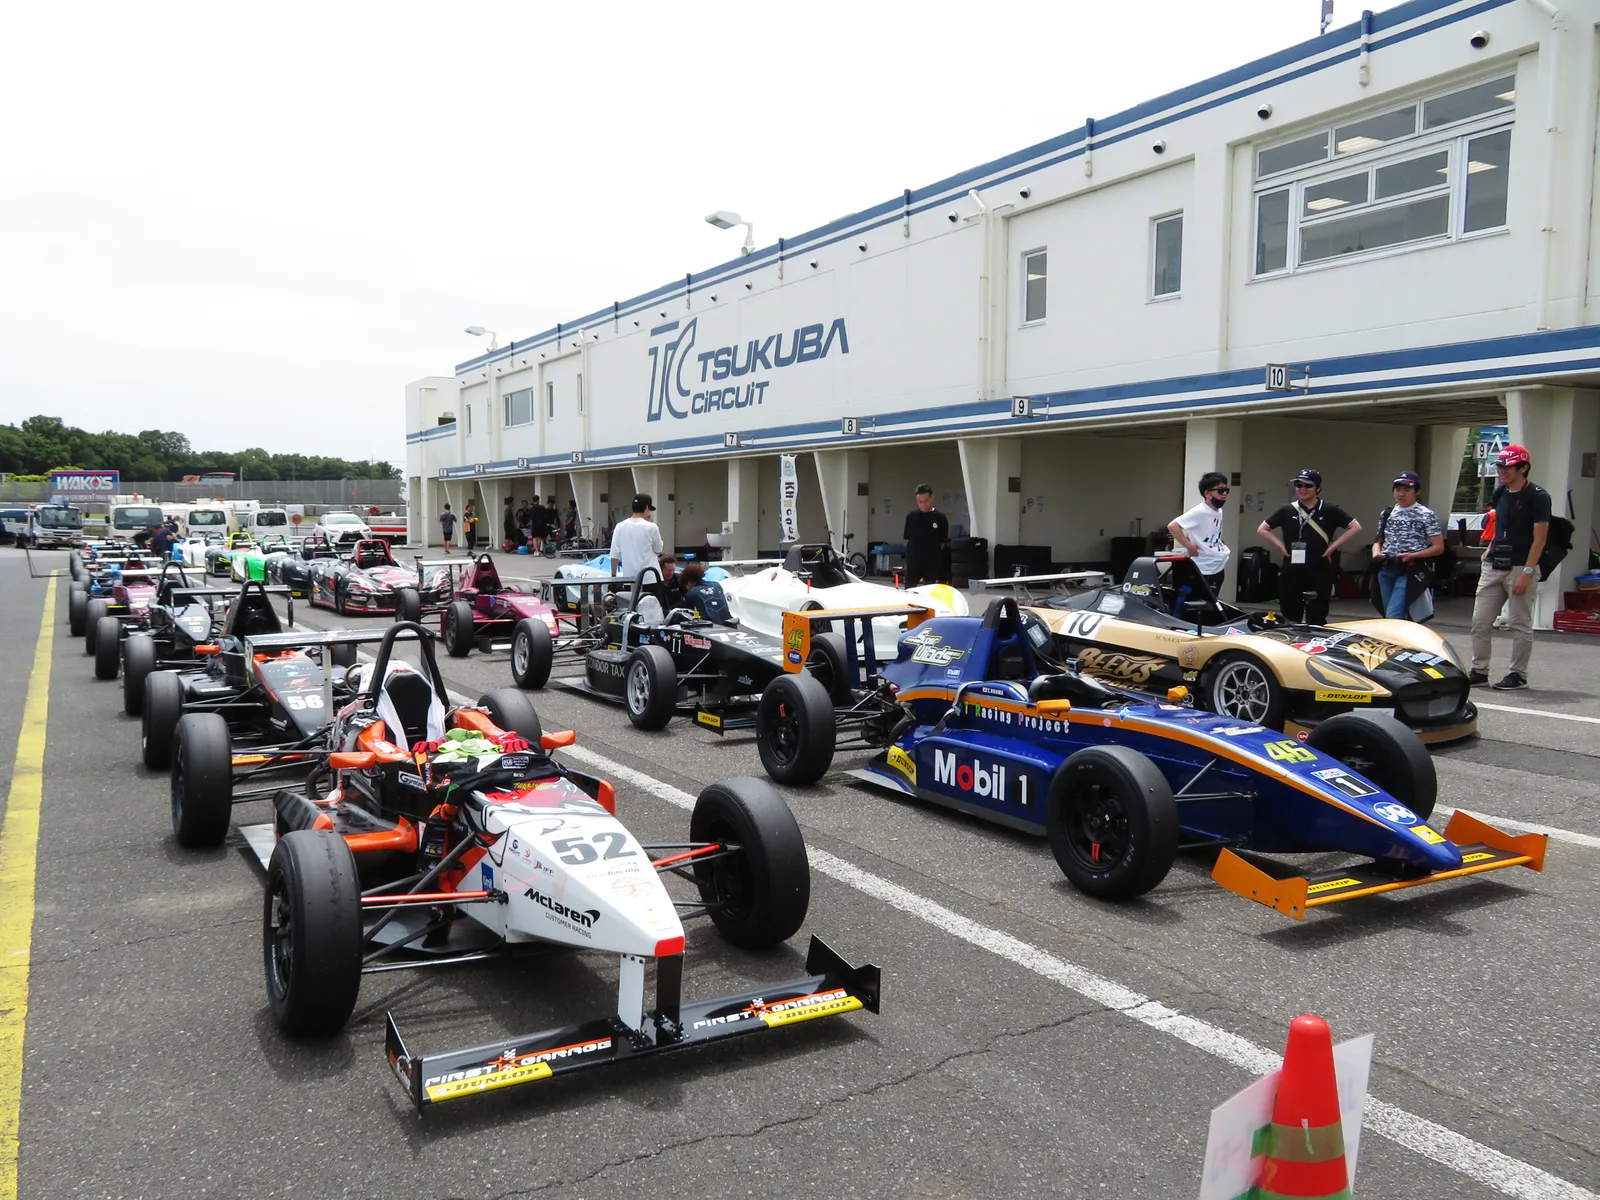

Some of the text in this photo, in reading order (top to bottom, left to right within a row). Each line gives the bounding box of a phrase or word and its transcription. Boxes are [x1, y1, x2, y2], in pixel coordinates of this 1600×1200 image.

[698, 318, 850, 383] TSUKUBA
[1272, 368, 1284, 387] 10
[1018, 399, 1025, 414] 9
[847, 419, 853, 432] 8
[641, 445, 647, 454] 6
[729, 434, 735, 444] 7
[1479, 444, 1485, 457] 9
[1068, 612, 1105, 637] 10
[671, 637, 682, 654] 11
[787, 628, 804, 651] 46
[586, 656, 625, 677] CONDOR TAX
[1077, 648, 1169, 683] BEENS
[287, 694, 325, 710] 56
[975, 702, 1012, 725] Racing
[1018, 711, 1070, 734] Project
[1263, 739, 1319, 765] 46
[896, 754, 915, 775] DUNLOP
[933, 748, 1028, 805] Mobil 1
[1334, 777, 1368, 795] 1
[551, 832, 637, 866] 52
[524, 887, 593, 928] McLaren
[545, 913, 592, 939] CUSTOMER RACING
[693, 989, 848, 1030] FIRST GARAGE
[784, 1000, 852, 1020] DUNLOP
[425, 1037, 612, 1088] FIRST GARAGE
[454, 1067, 541, 1092] DUNLOP
